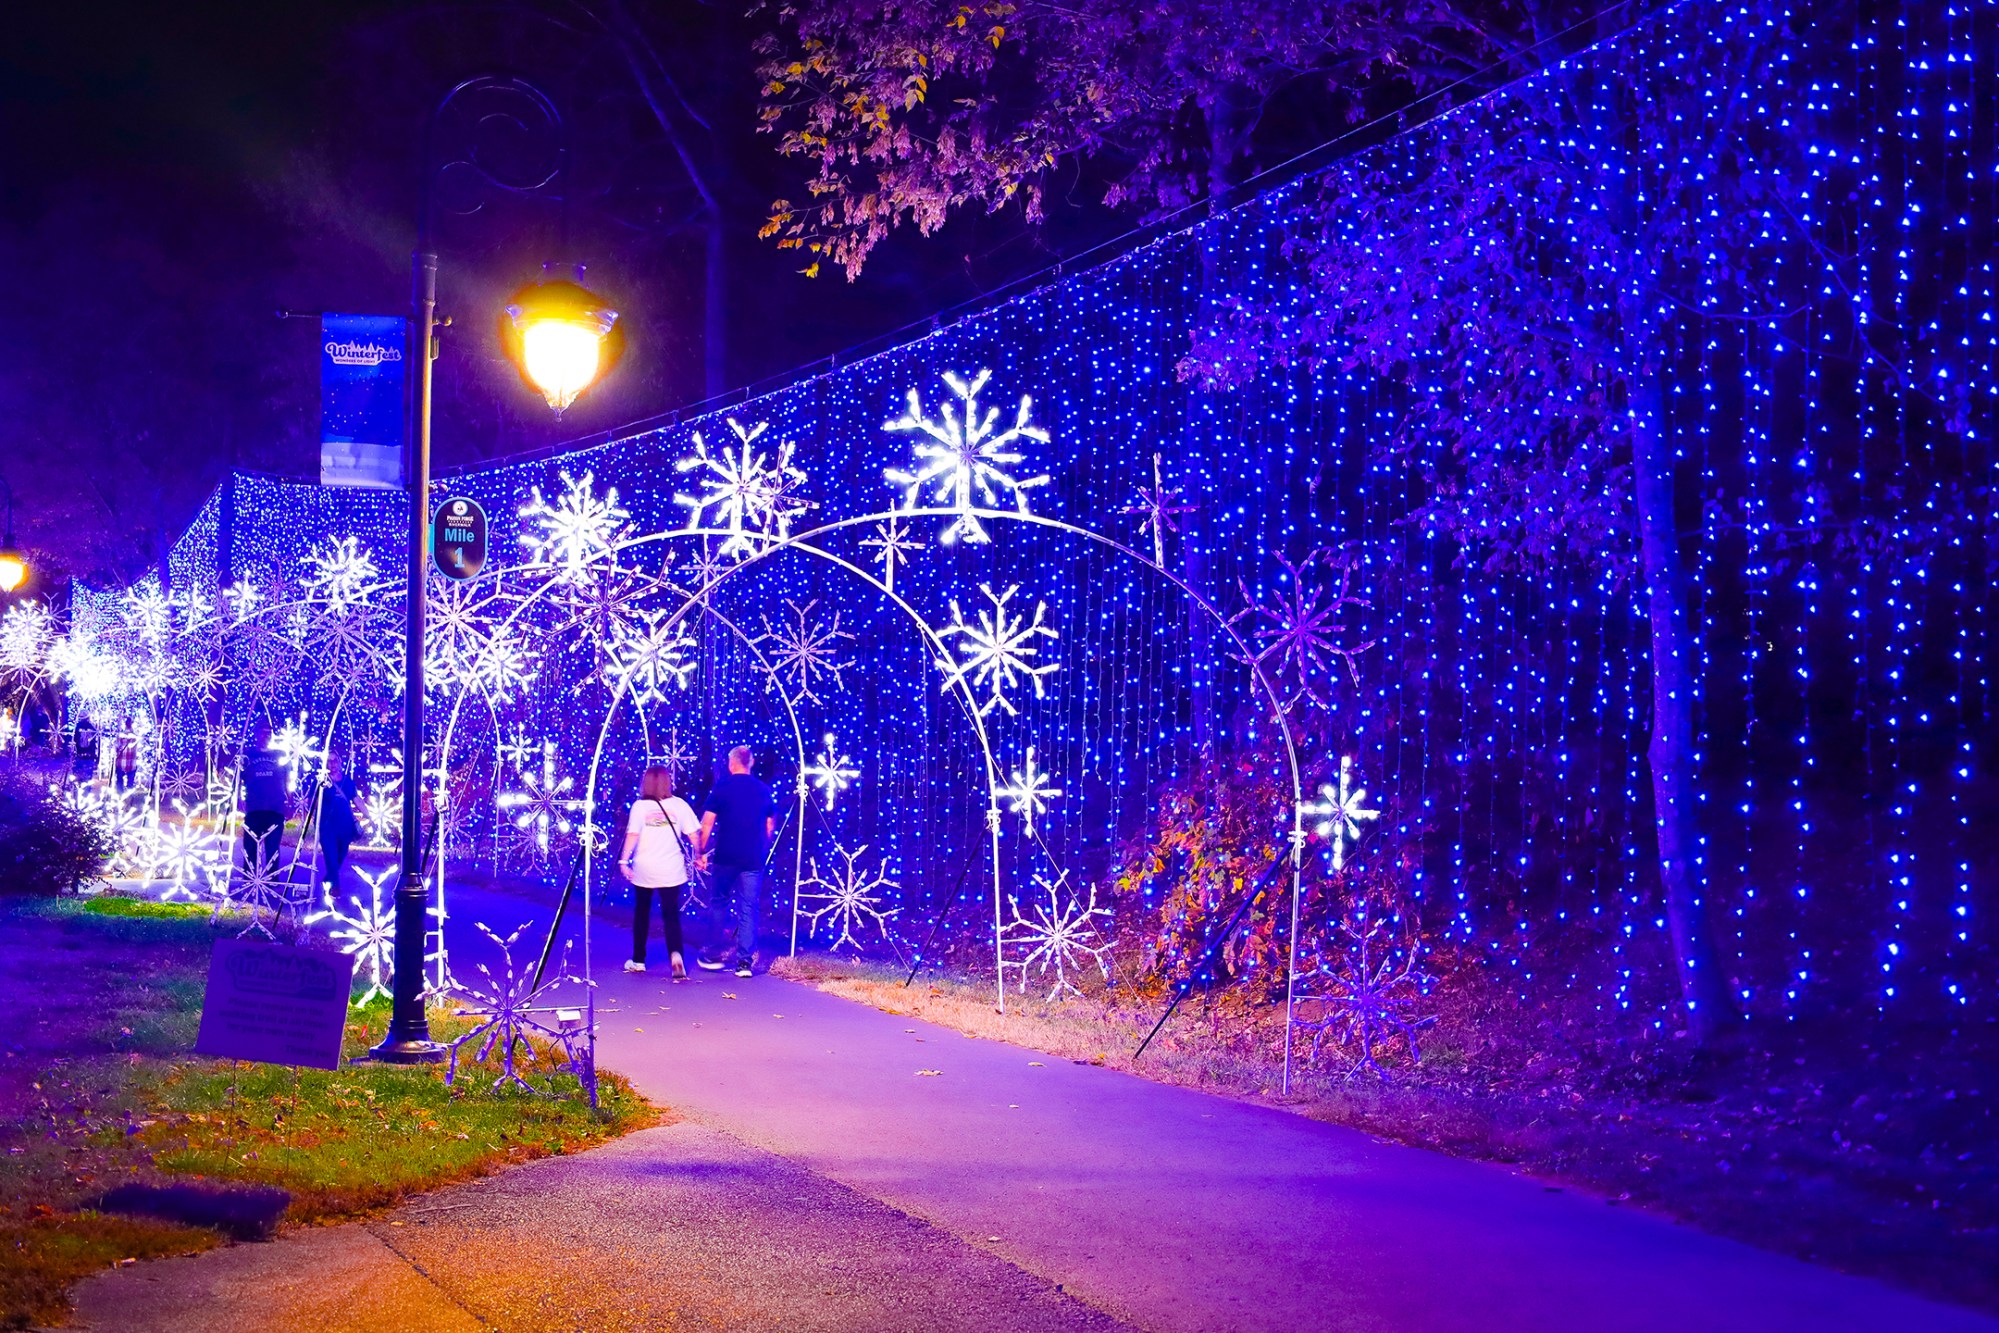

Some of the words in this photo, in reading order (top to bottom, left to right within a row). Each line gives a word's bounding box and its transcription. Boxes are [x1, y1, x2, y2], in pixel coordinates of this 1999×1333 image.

[326, 343, 400, 361] Winterfest
[444, 528, 475, 543] Mile
[454, 547, 465, 568] 1
[229, 954, 332, 988] Winterfest
